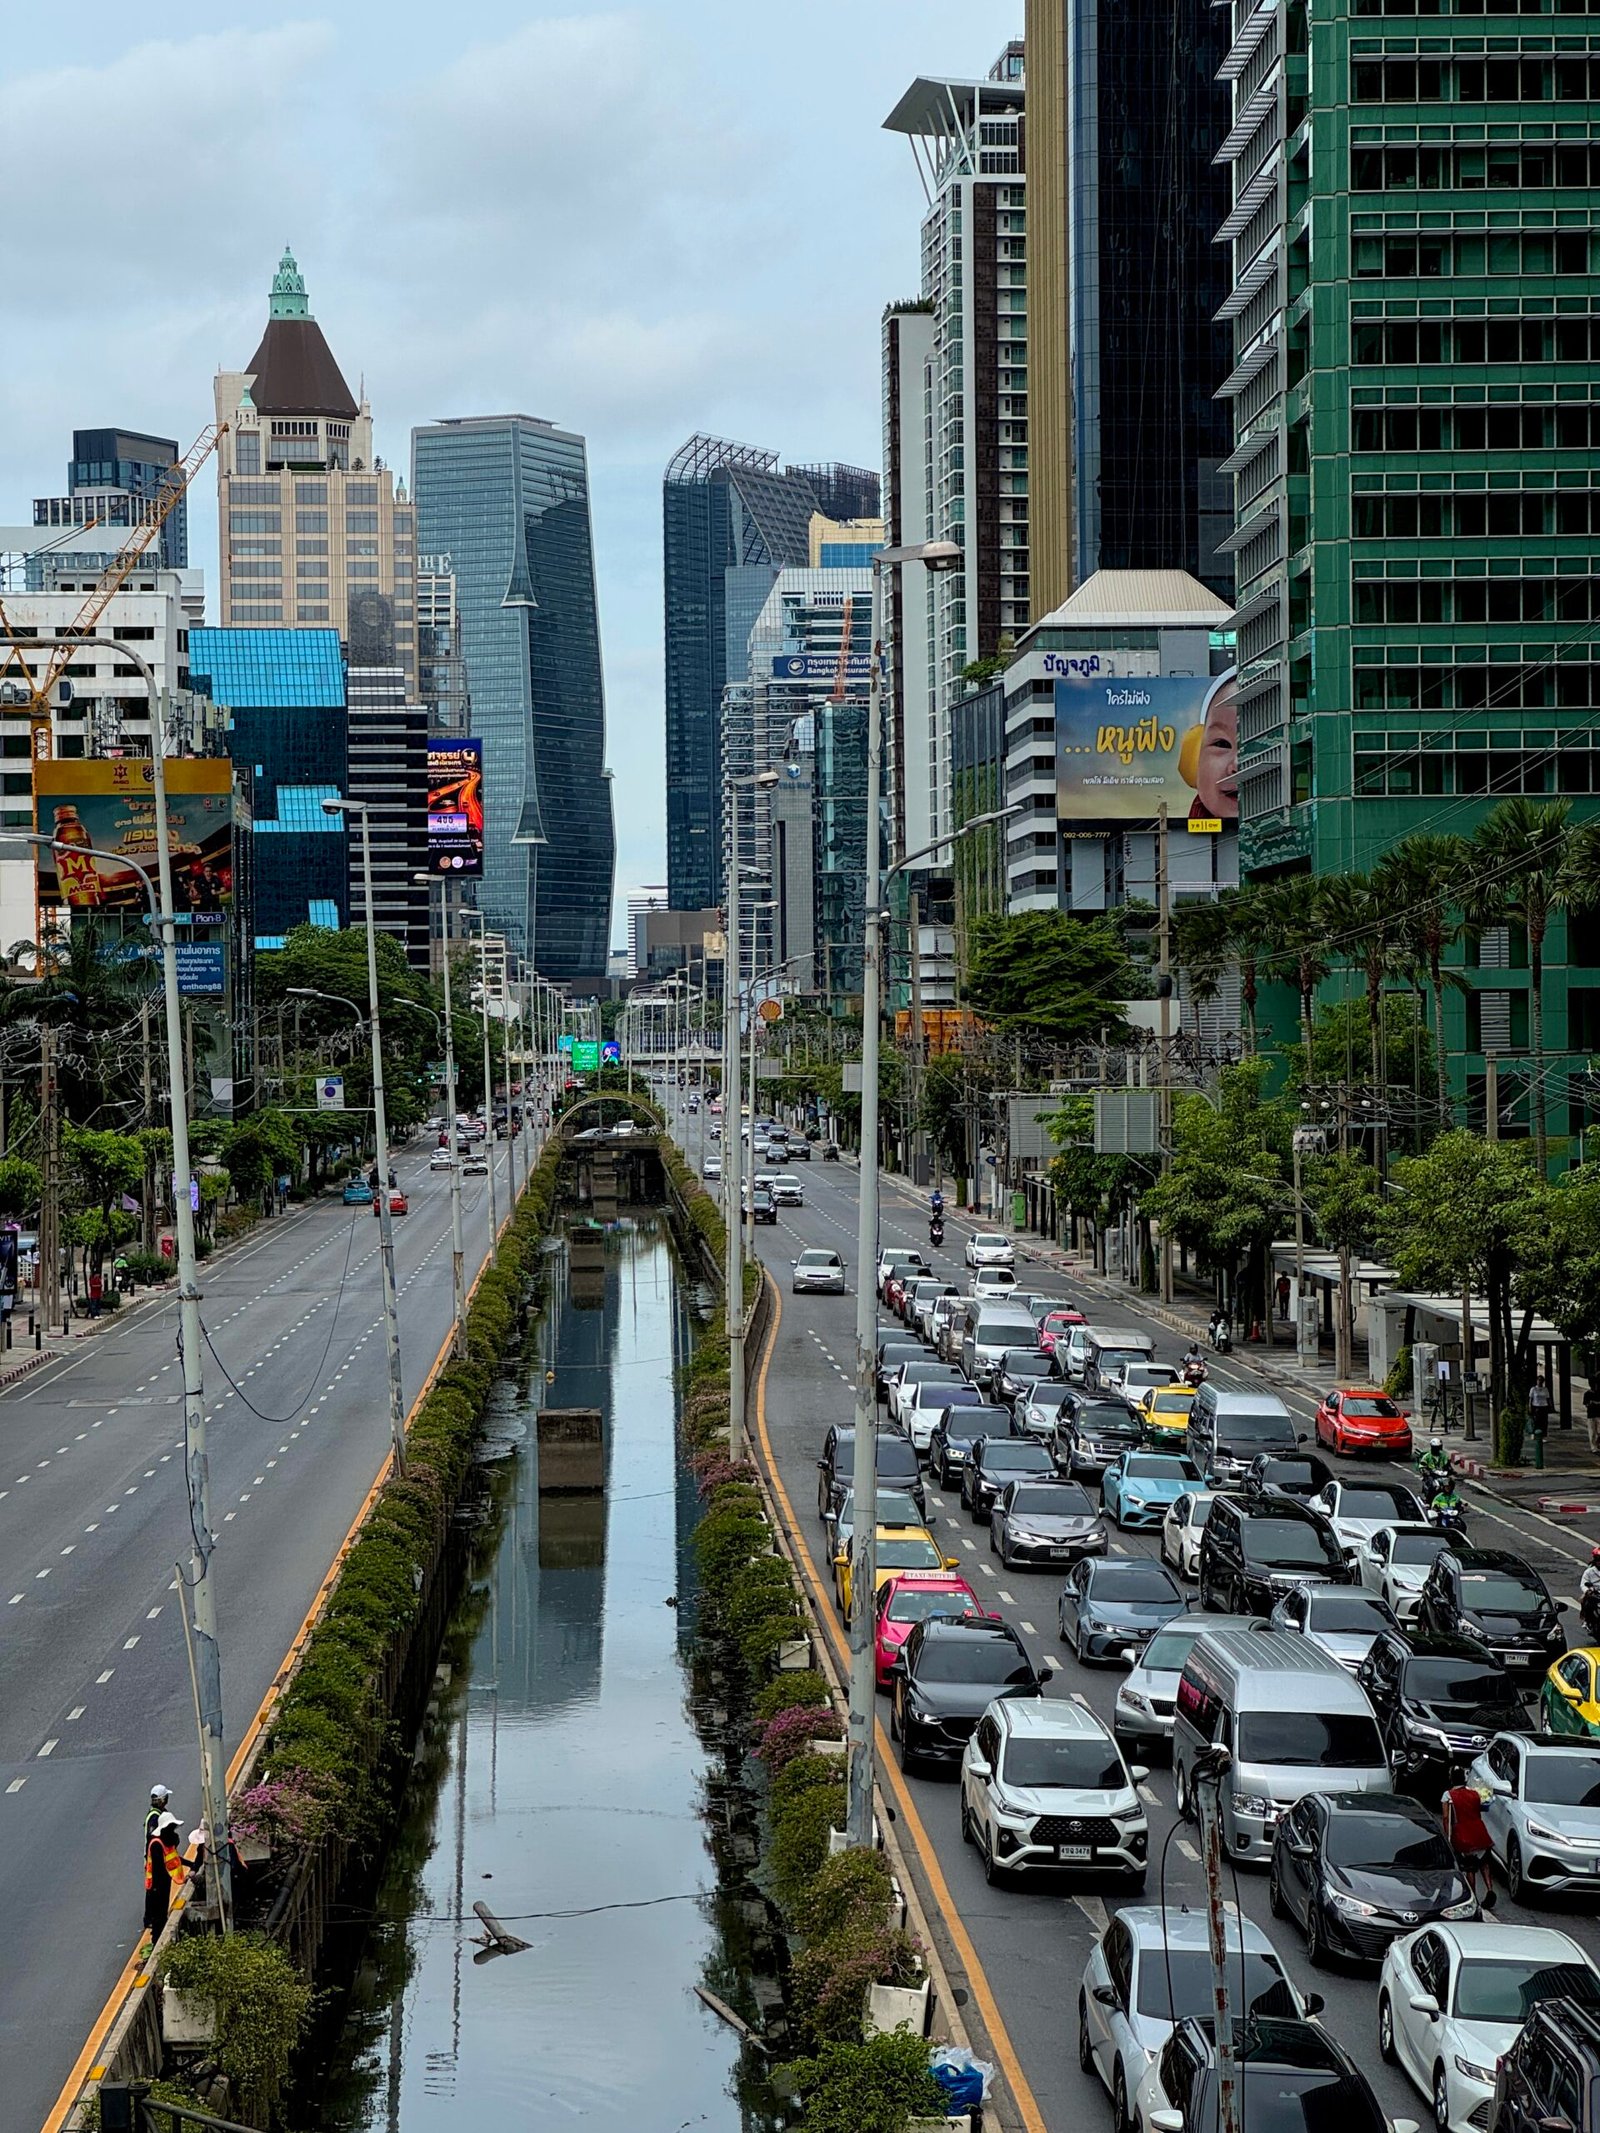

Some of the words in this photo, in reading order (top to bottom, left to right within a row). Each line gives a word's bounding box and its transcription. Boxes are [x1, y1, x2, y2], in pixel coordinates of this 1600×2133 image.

[1043, 654, 1100, 677] ปัญจภูมิ
[1106, 689, 1151, 705] ใครไม่ฟัง
[1190, 820, 1219, 830] yellow
